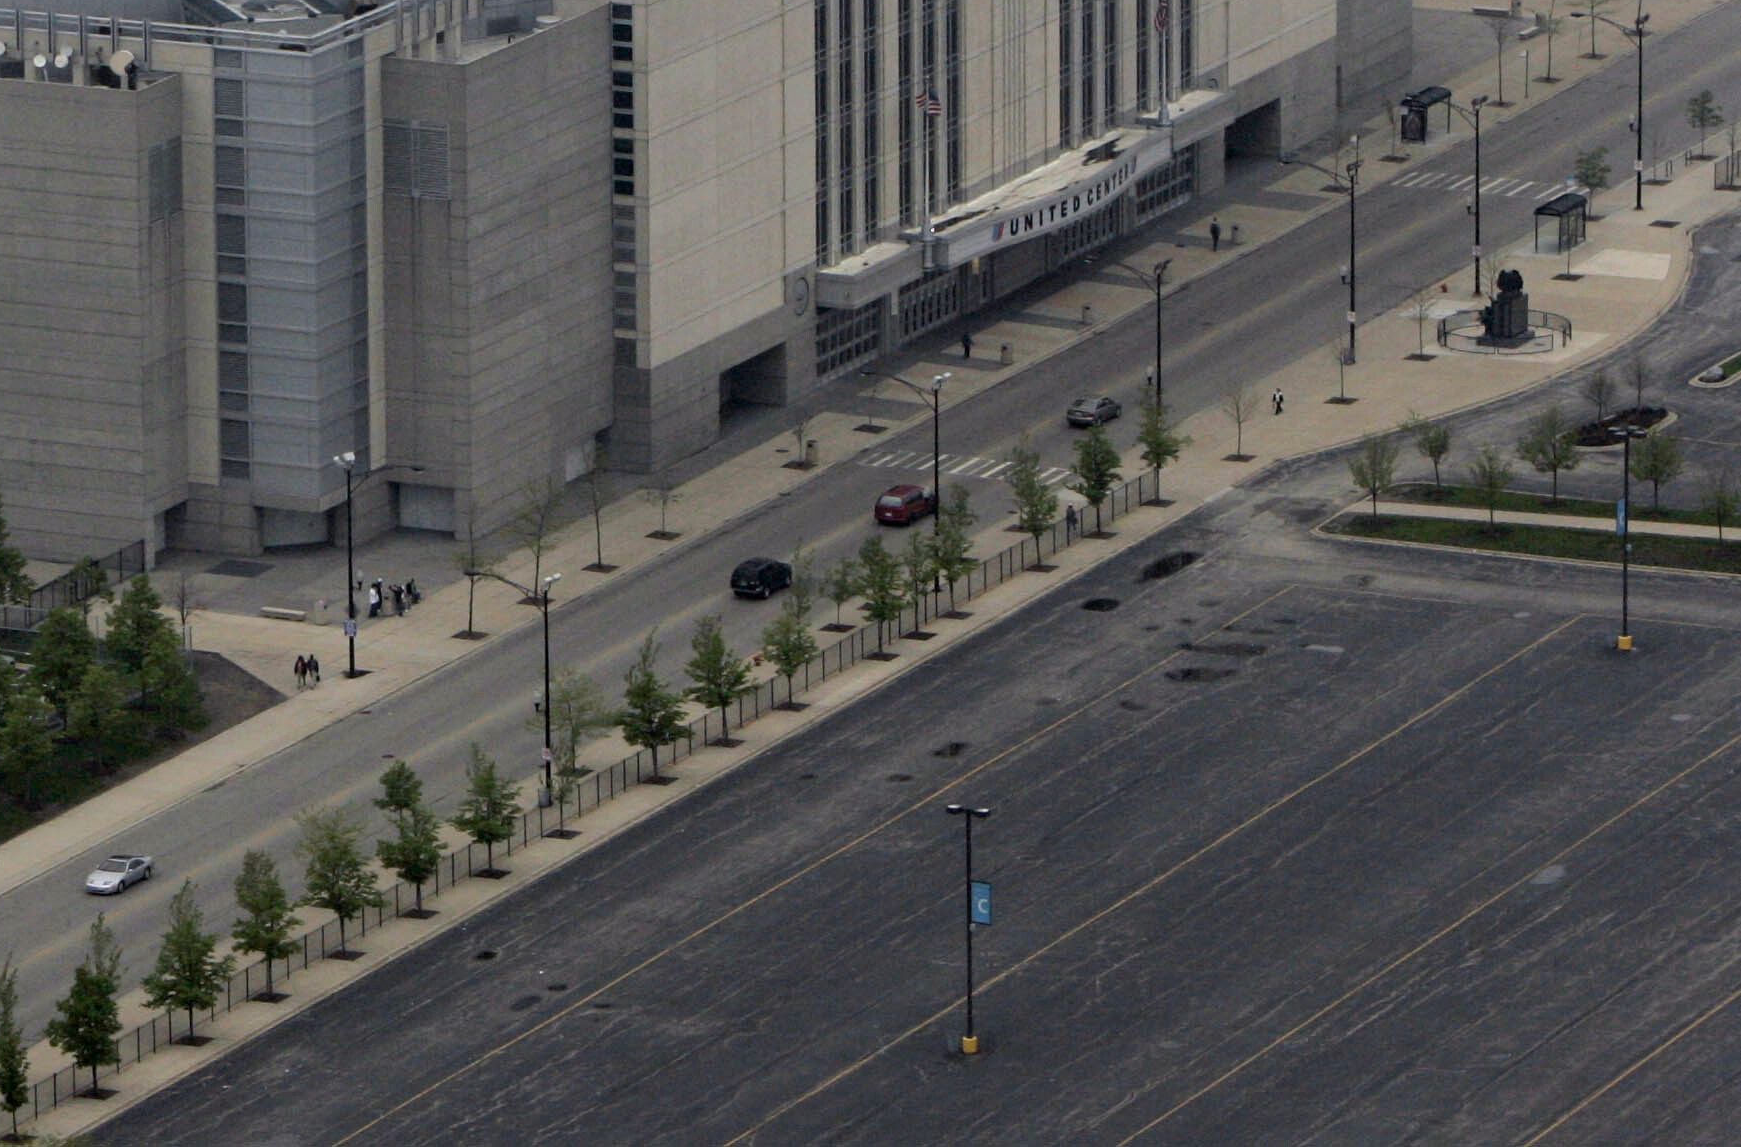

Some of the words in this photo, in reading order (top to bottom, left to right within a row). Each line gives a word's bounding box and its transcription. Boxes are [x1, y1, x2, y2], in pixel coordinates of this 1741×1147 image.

[1010, 196, 1081, 237] UNITED
[1087, 164, 1129, 206] CENTER
[977, 898, 989, 914] C
